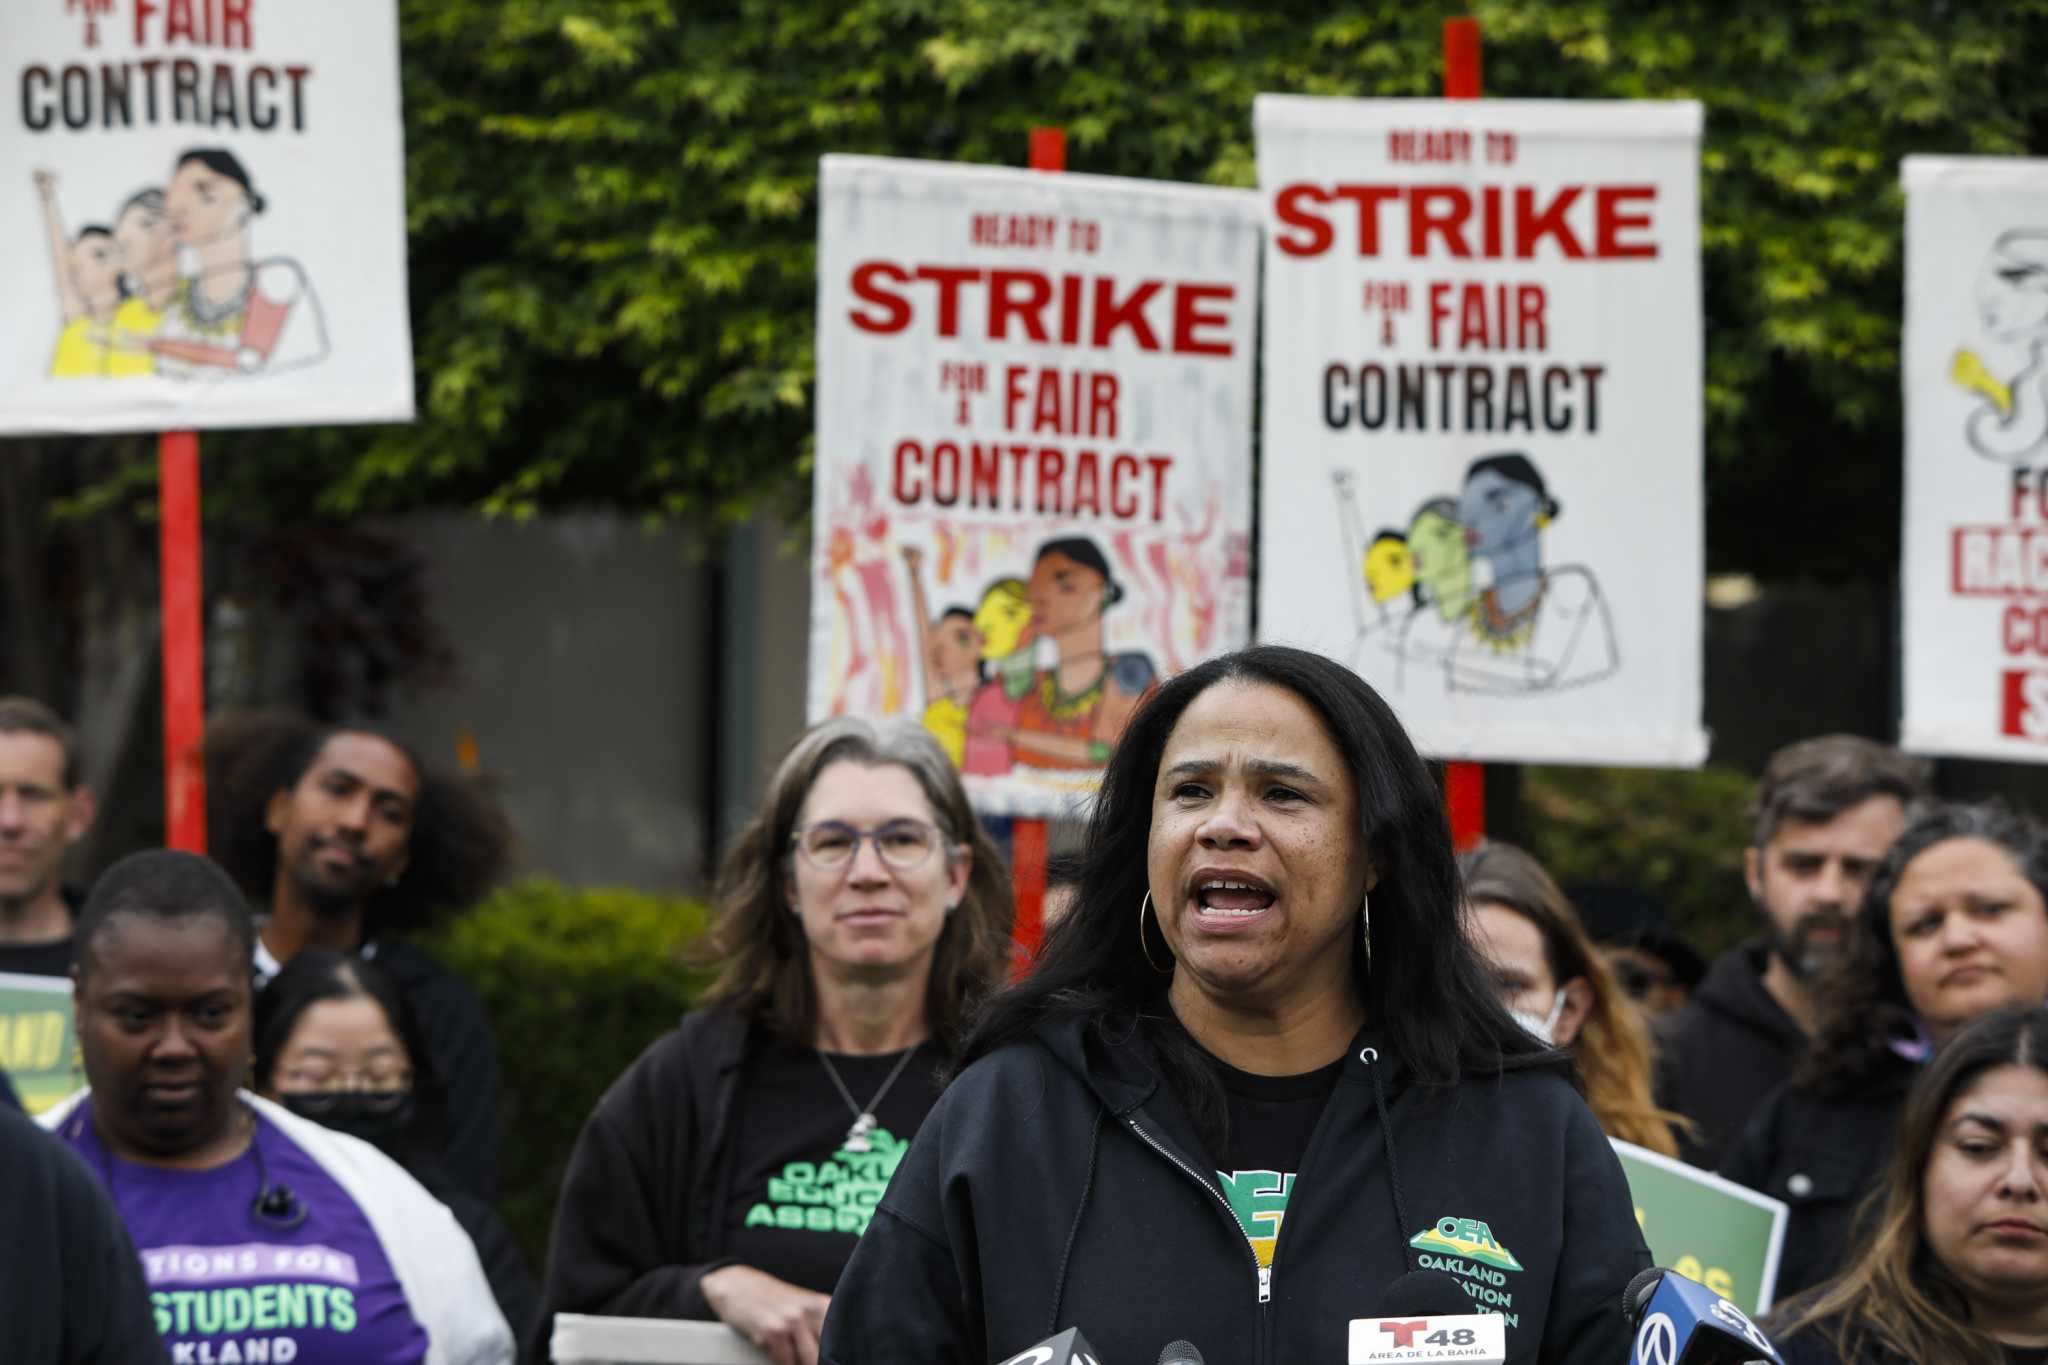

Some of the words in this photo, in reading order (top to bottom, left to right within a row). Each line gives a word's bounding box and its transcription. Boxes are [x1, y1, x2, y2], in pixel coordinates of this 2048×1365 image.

[133, 0, 253, 48] FAIR
[20, 58, 312, 132] CONTRACT
[1387, 129, 1471, 164] READY
[1486, 131, 1518, 165] TO
[970, 213, 1056, 249] READY
[1069, 219, 1100, 253] TO
[1274, 182, 1658, 260] STRIKE
[848, 261, 1236, 358] STRIKE
[1364, 281, 1410, 312] FOR
[1428, 282, 1548, 352] FAIR
[940, 362, 986, 393] FOR
[1322, 362, 1606, 435] CONTRACT
[1004, 366, 1120, 440] FAIR
[893, 440, 1174, 522] CONTRACT
[1436, 1216, 1497, 1251] OEA
[275, 1251, 343, 1272] FOR
[1418, 1254, 1507, 1287] OAKLAND
[150, 1284, 357, 1335] STUDENTS
[1407, 1350, 1423, 1358] DE
[1424, 1328, 1476, 1346] 48
